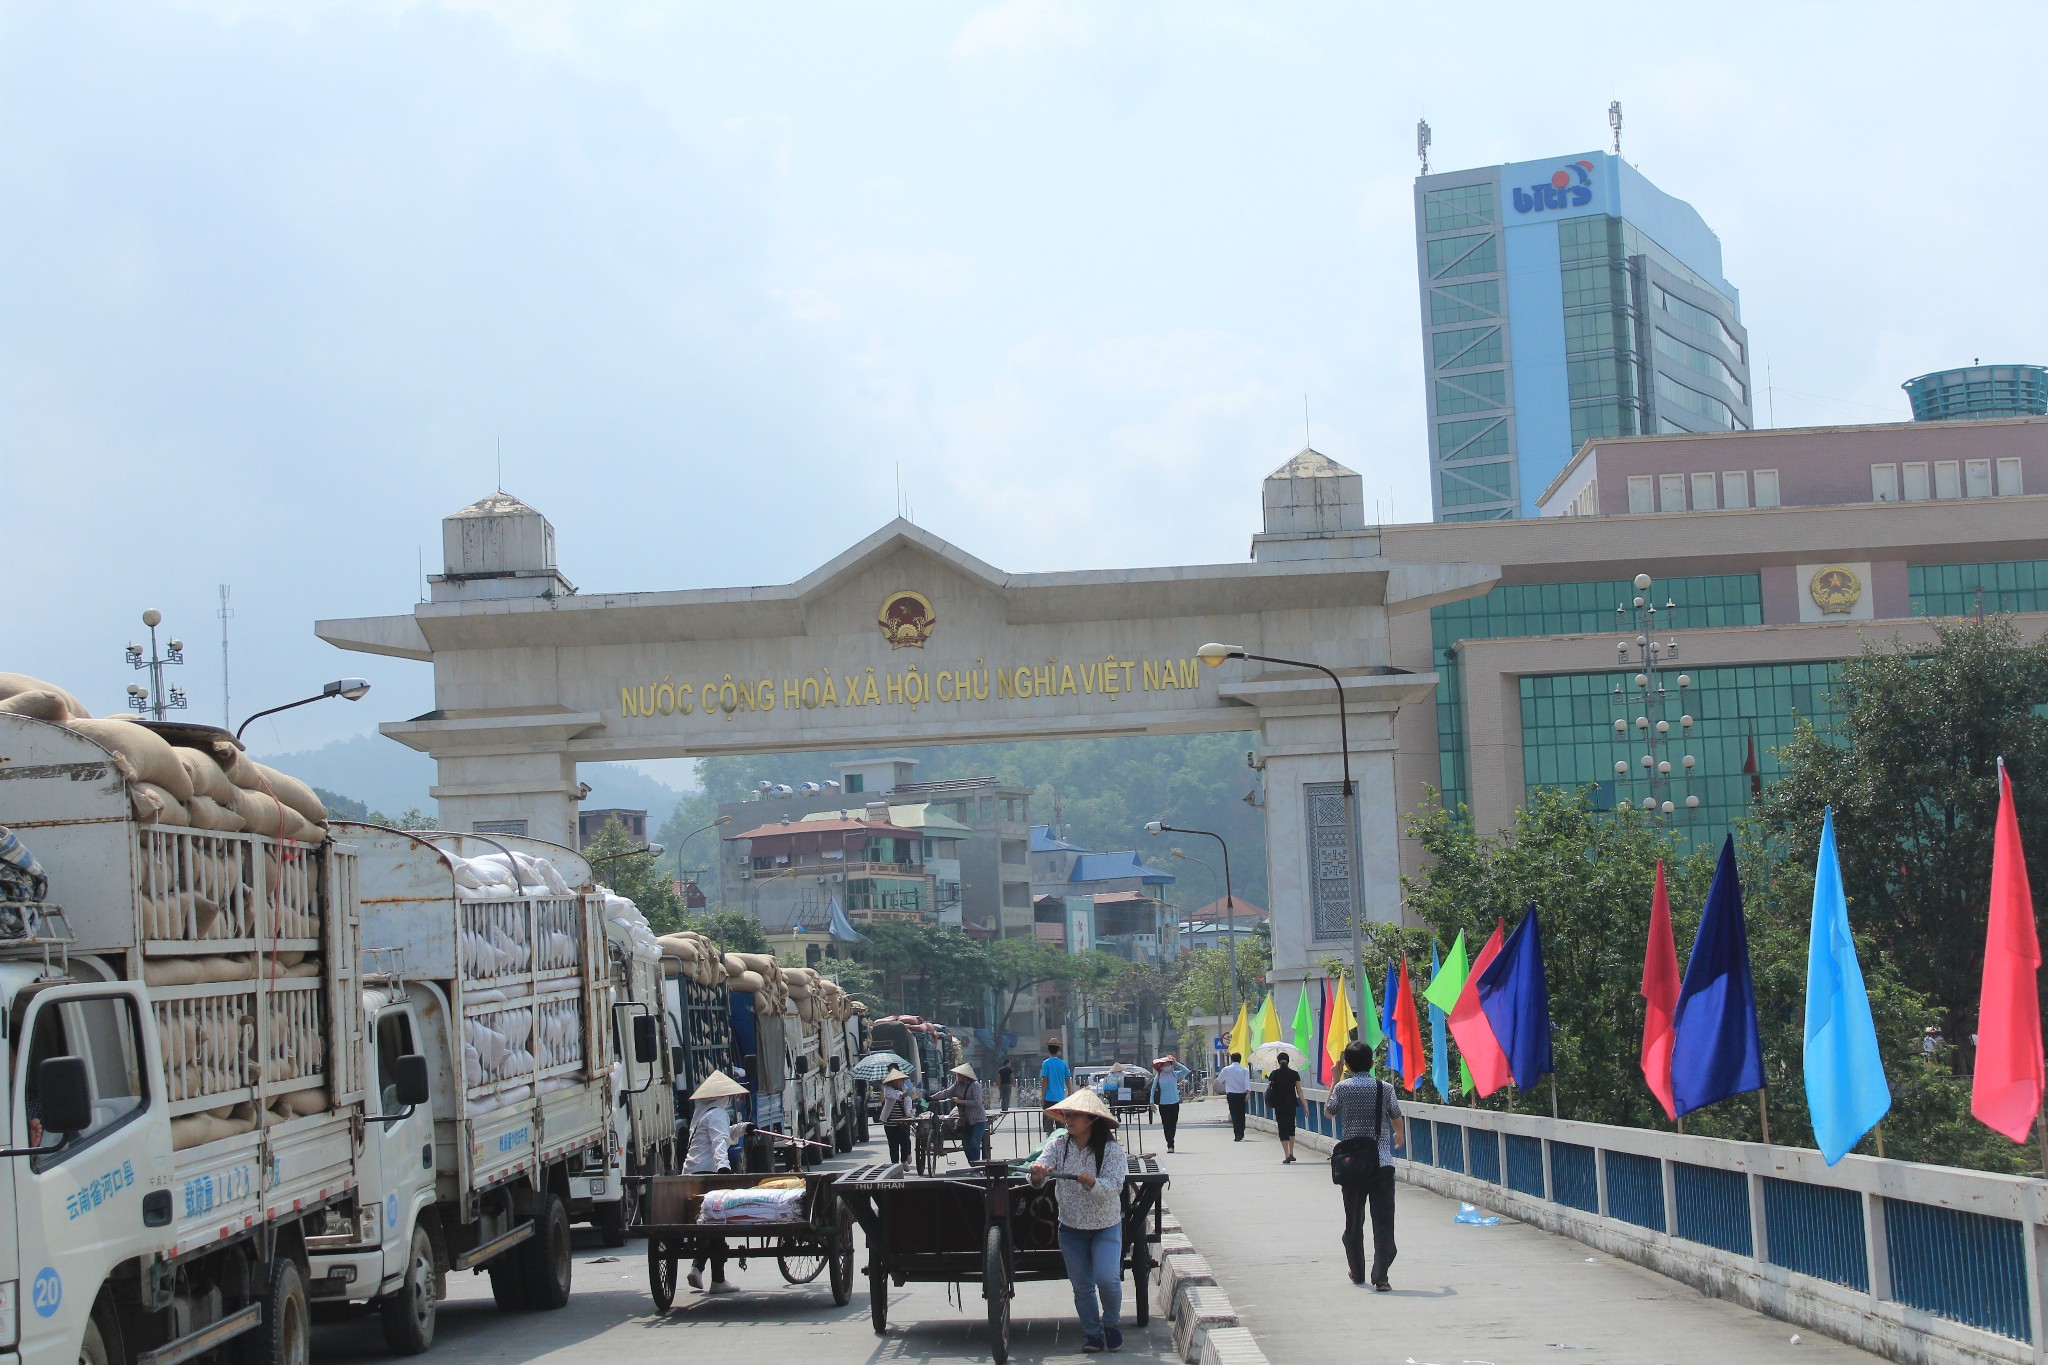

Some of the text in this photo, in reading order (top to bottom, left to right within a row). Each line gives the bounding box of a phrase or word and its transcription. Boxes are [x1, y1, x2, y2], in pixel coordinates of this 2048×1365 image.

[621, 654, 1200, 721] NƯỚC CỘNG HOÀ XÃ HỘI CHỦ NGHĨA VIỆT NAM
[65, 1159, 136, 1221] 云南省河口县
[36, 1276, 59, 1308] 20
